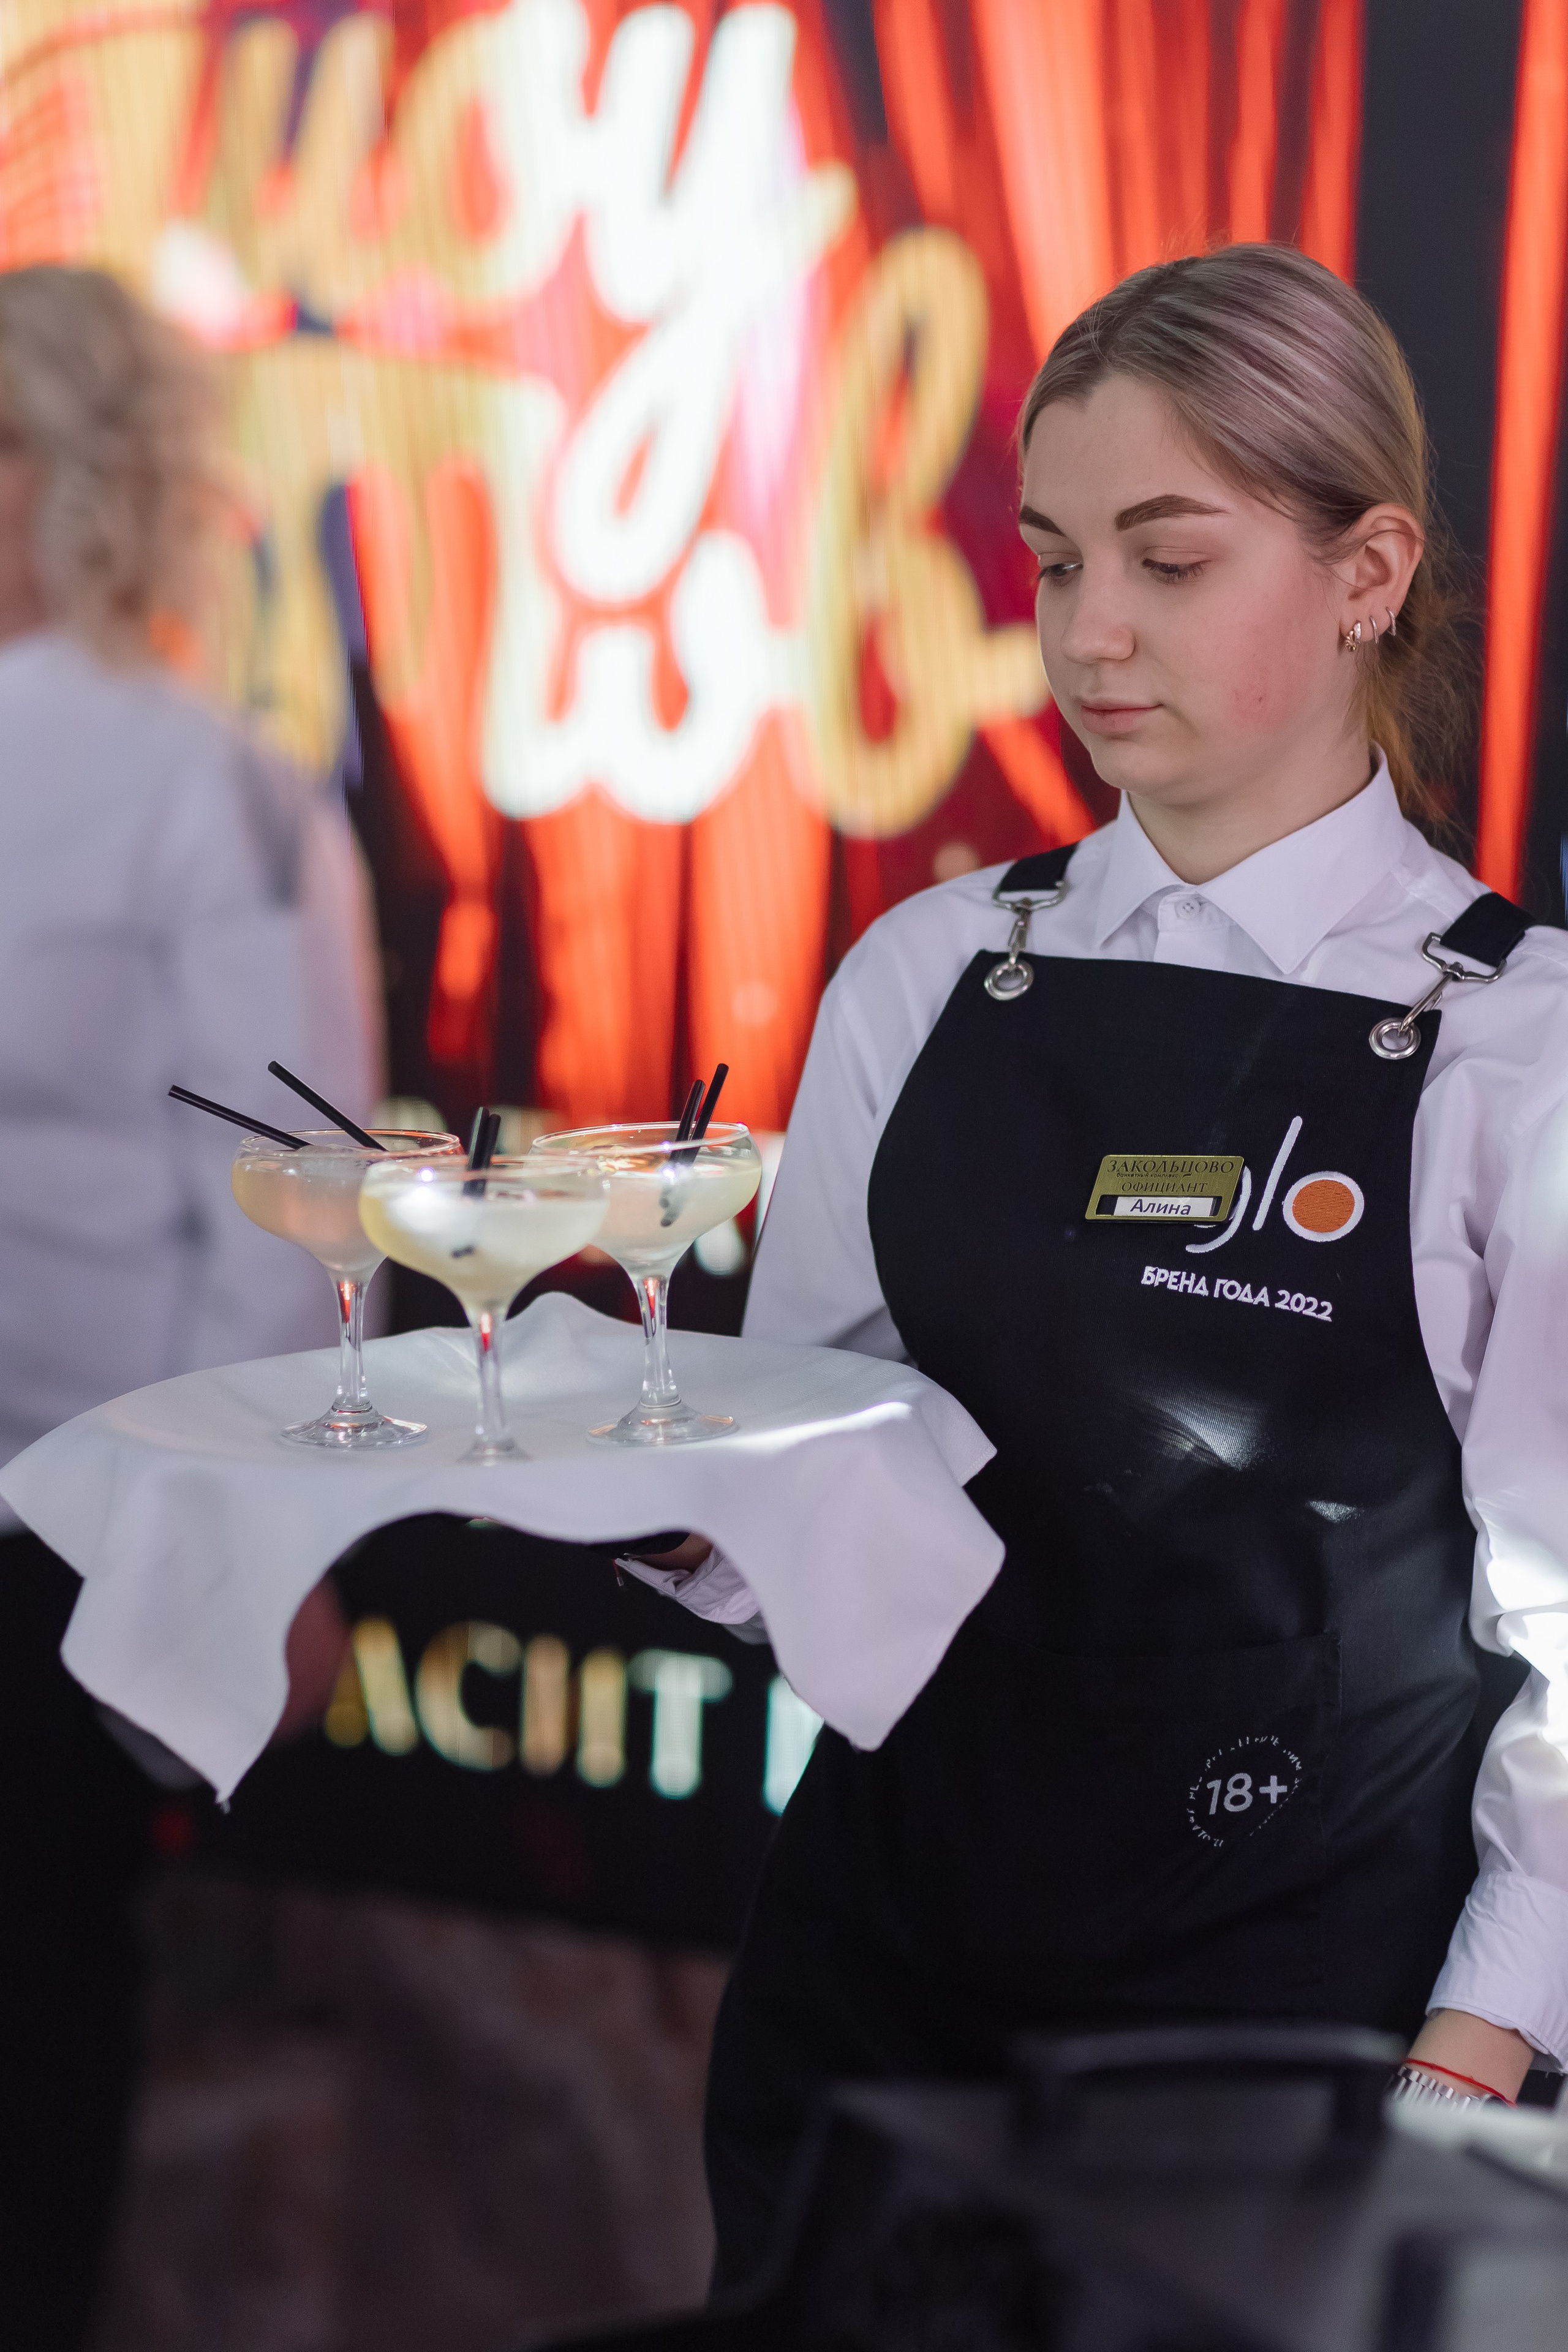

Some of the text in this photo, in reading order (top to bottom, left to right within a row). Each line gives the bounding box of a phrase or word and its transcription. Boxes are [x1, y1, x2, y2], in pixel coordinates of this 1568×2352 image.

[1107, 1159, 1235, 1175] ЗАКОЛЬЦОВО
[1121, 1182, 1208, 1193] ОФИЦИАНТ
[1130, 1198, 1192, 1215] Алина
[1140, 1265, 1333, 1322] БРЕНД ГОДА 2022
[1206, 1772, 1287, 1815] 18+
